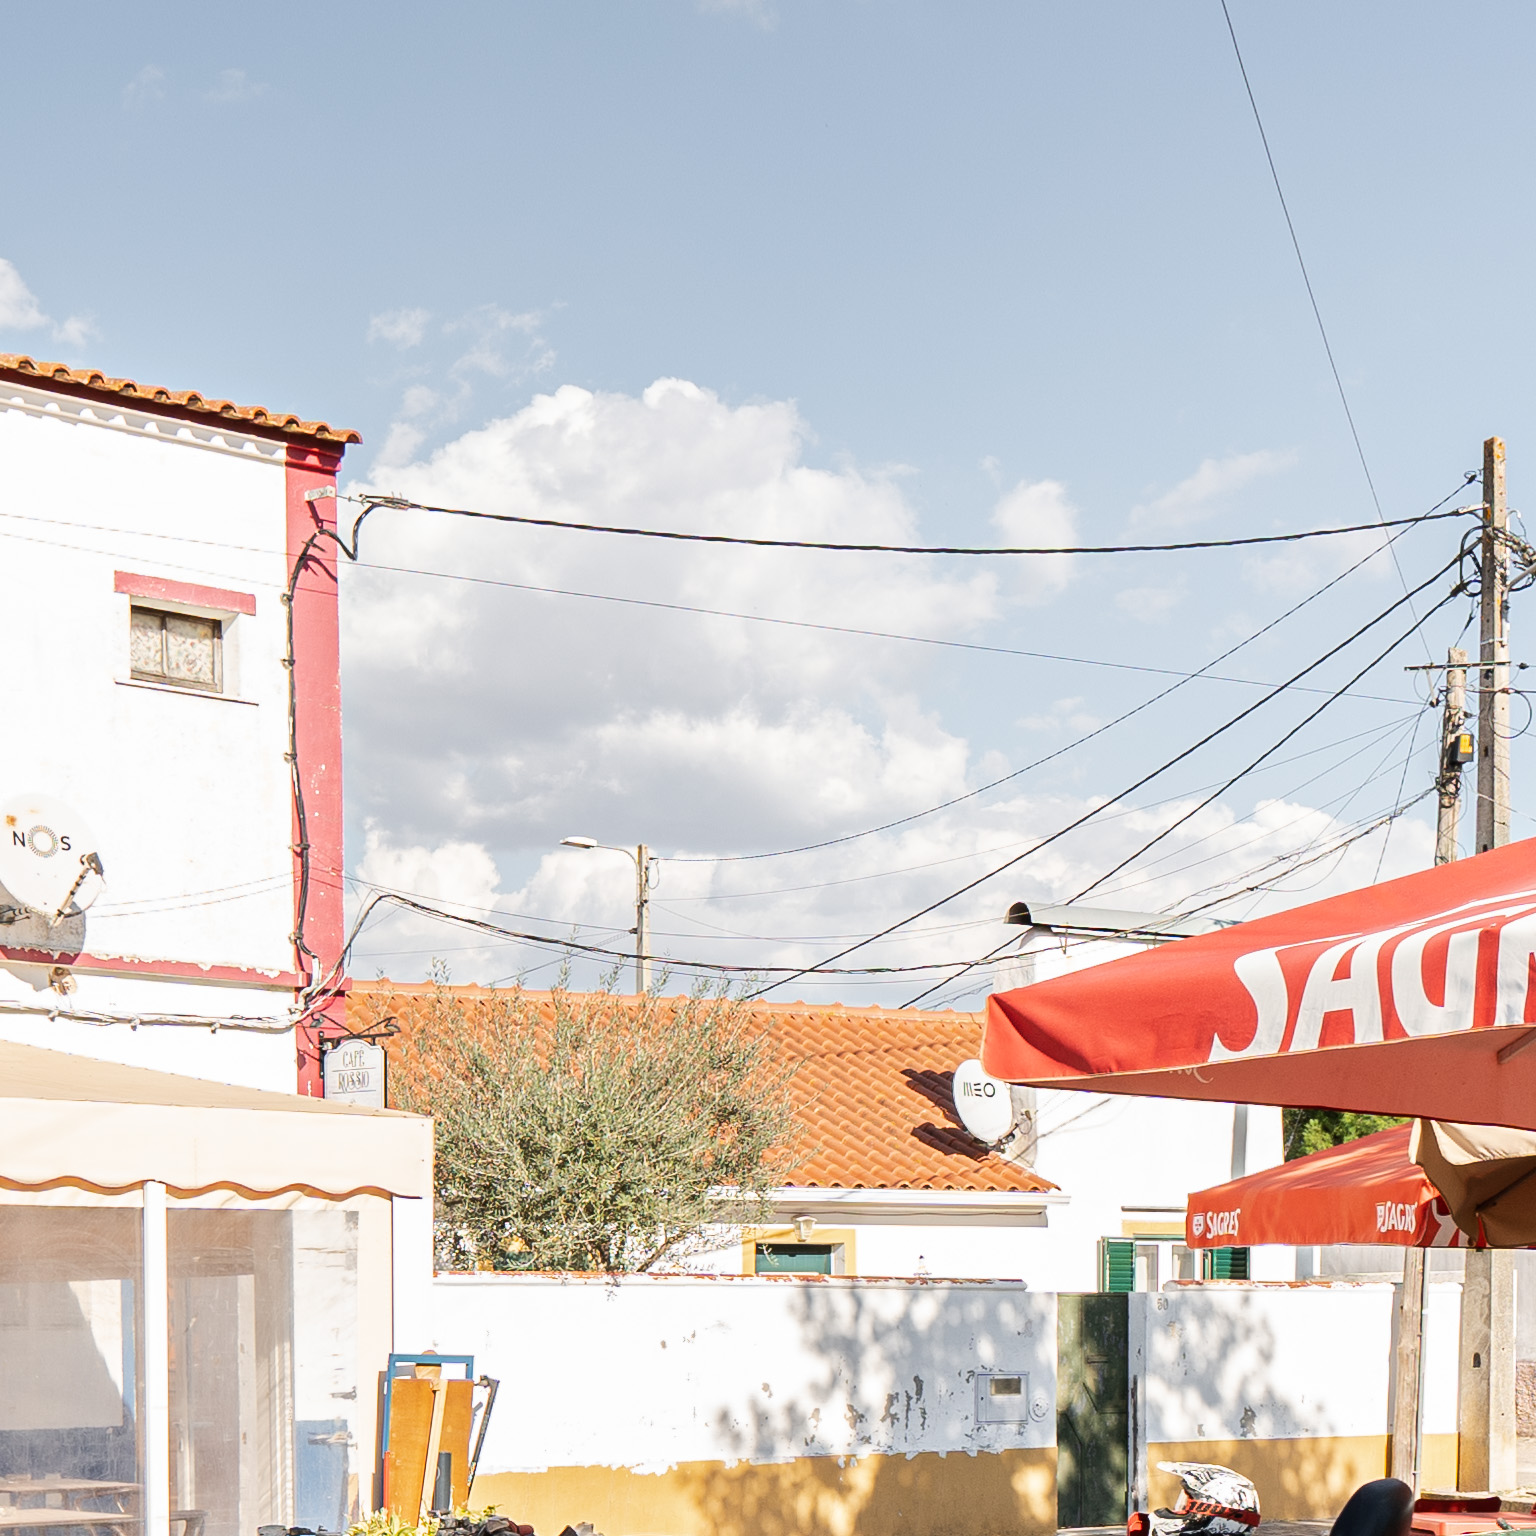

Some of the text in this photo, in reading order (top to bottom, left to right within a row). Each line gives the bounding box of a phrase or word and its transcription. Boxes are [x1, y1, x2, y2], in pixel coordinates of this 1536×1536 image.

[12, 825, 72, 858] NOS
[342, 1046, 365, 1068] CAFÉ
[338, 1071, 370, 1094] ROSSIO
[963, 1082, 996, 1098] MEO
[1205, 1208, 1241, 1239] SAGRES
